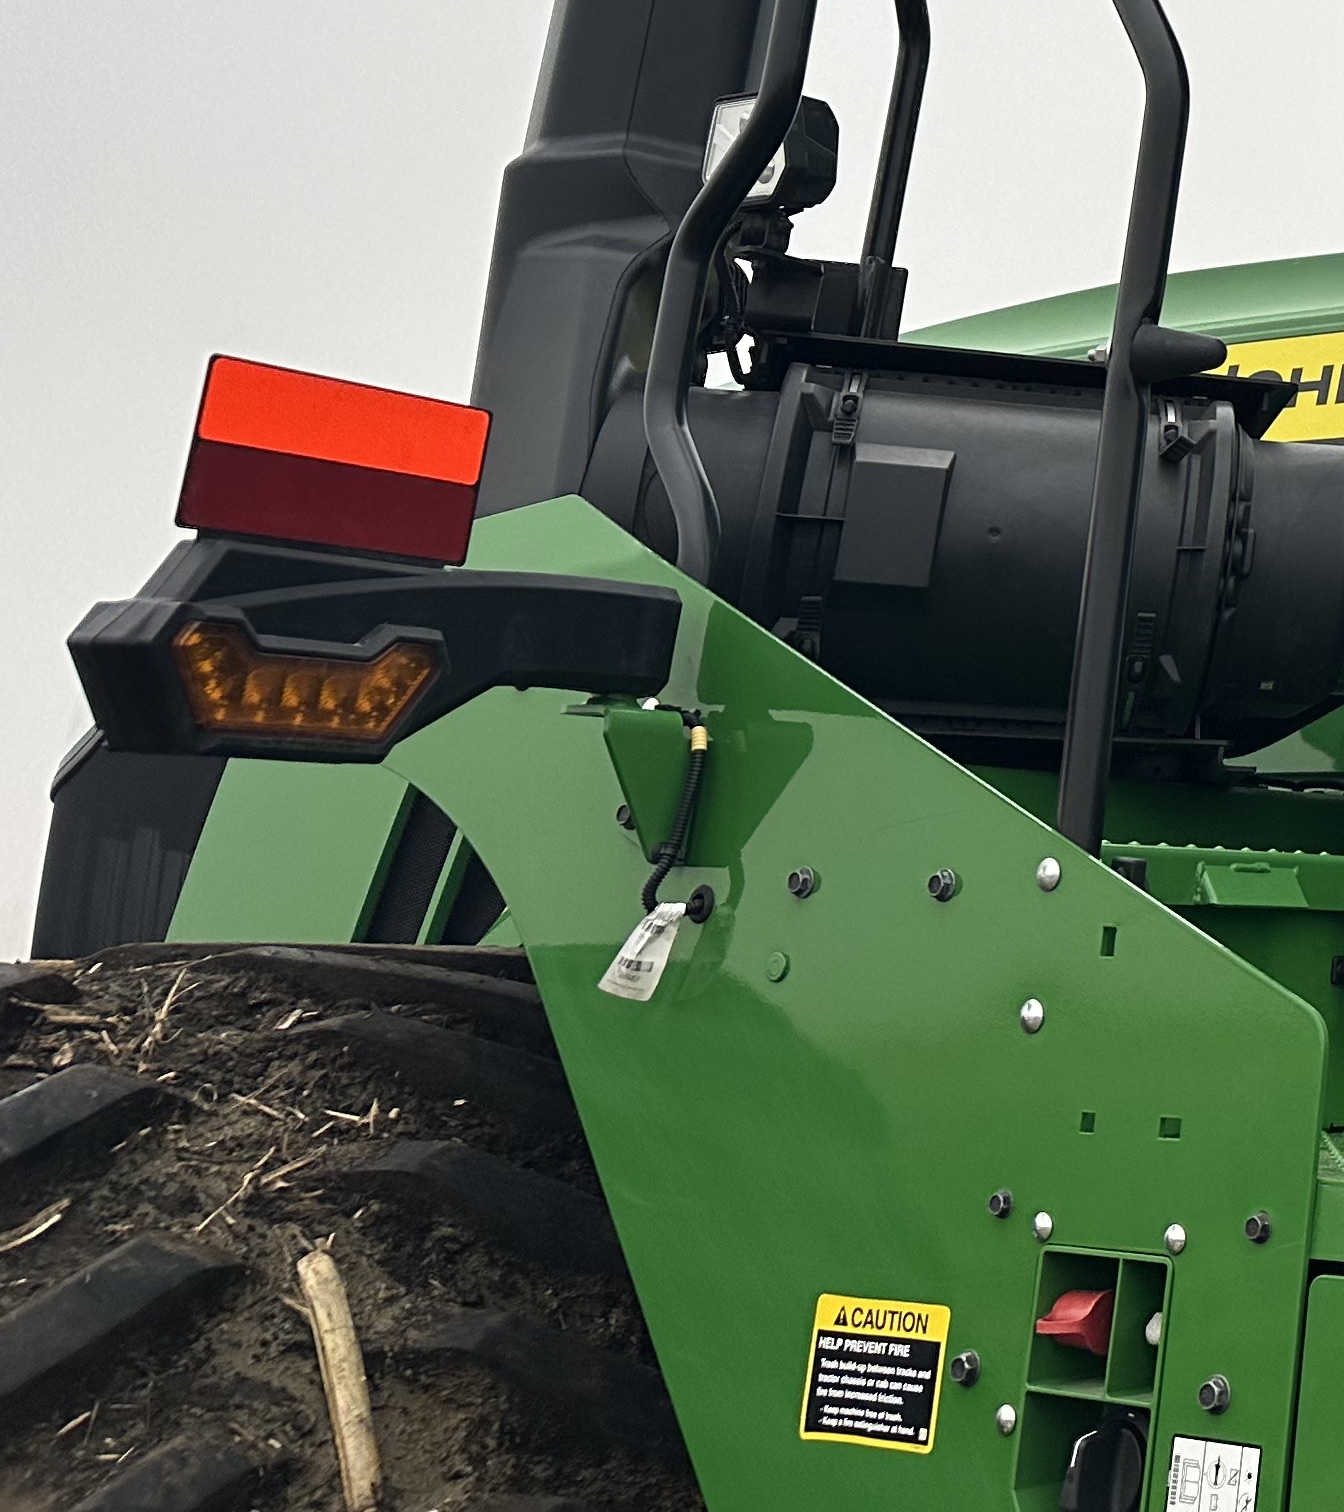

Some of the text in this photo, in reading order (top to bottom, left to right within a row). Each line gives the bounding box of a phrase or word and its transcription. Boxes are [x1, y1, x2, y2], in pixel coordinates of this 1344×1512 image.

[852, 1307, 929, 1334] CAUTION
[818, 1336, 911, 1357] HELP PREVENT FIRE
[866, 1363, 895, 1375] between
[918, 1370, 931, 1379] and
[867, 1379, 876, 1387] or
[828, 1387, 844, 1398] from
